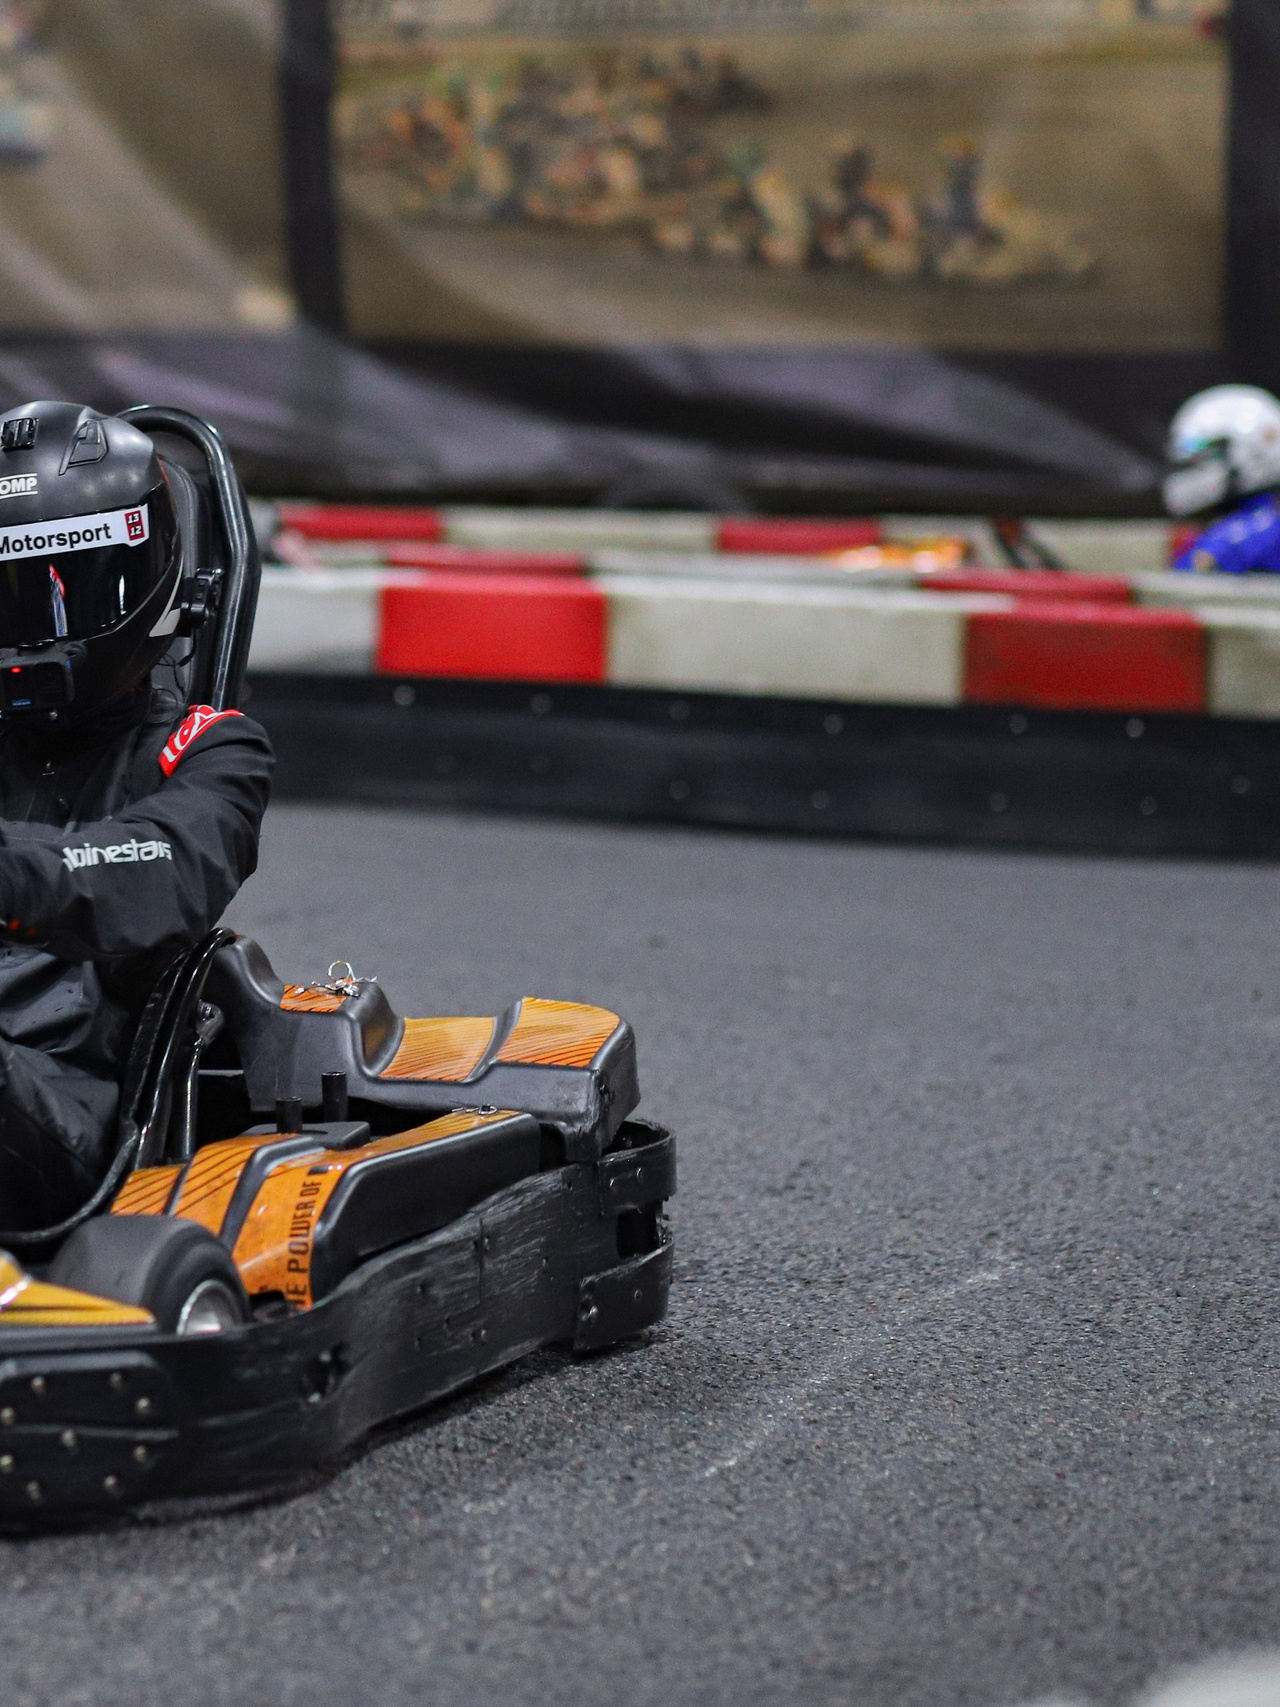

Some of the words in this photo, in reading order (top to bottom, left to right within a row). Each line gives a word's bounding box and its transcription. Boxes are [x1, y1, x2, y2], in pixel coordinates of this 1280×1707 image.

[127, 513, 140, 524] 13
[130, 525, 142, 536] 12
[299, 1180, 322, 1198] OF
[287, 1200, 316, 1274] POWER
